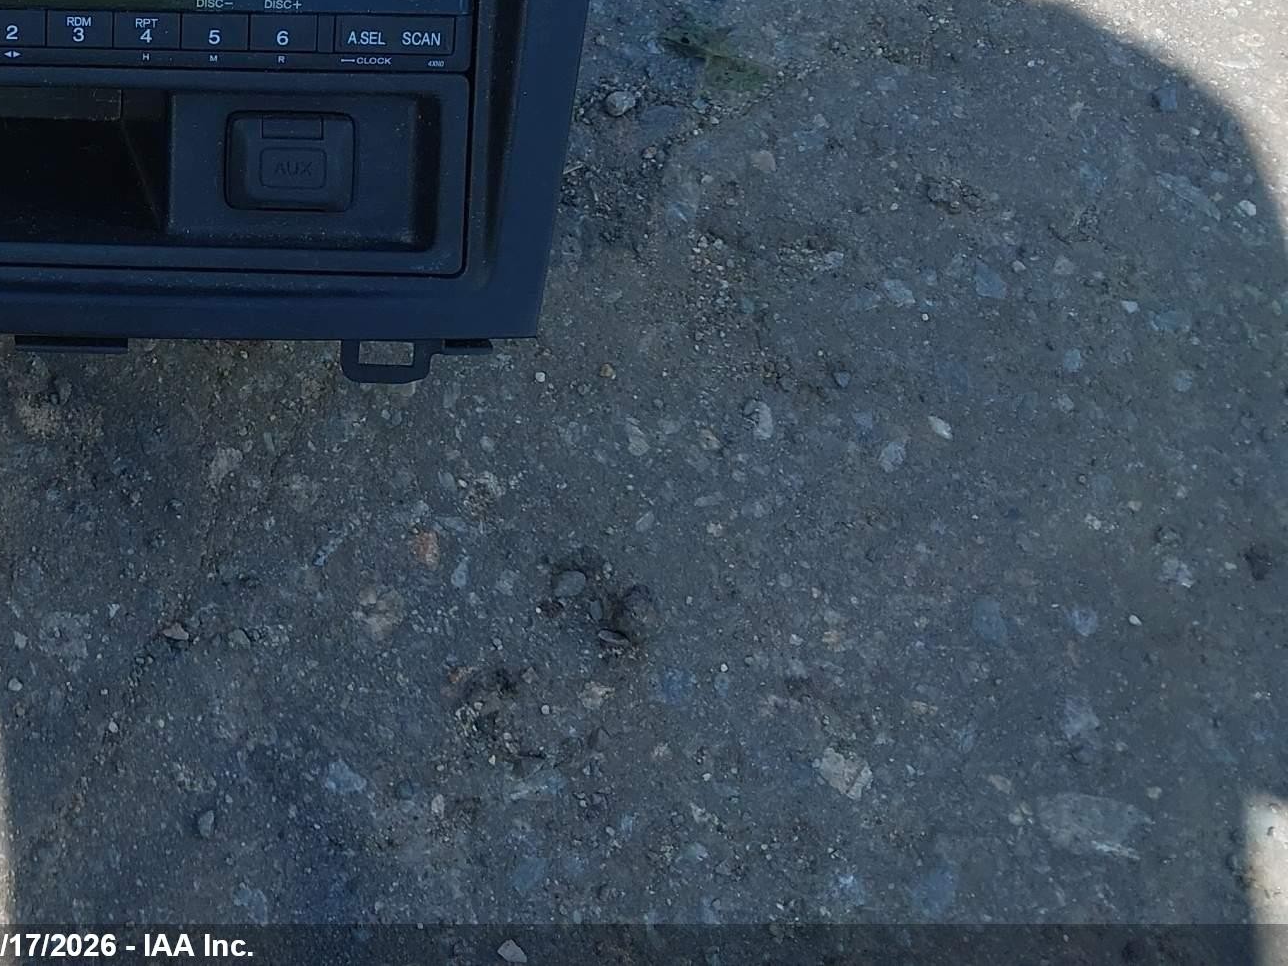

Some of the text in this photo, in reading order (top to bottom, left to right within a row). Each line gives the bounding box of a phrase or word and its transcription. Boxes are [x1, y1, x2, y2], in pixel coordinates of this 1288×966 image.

[264, 0, 302, 10] DISC+
[66, 16, 92, 27] RDM
[135, 18, 159, 28] RPT
[5, 25, 19, 40] 2
[72, 27, 85, 42] 3
[139, 28, 153, 43] 4
[208, 30, 221, 45] 5
[276, 31, 289, 46] 6
[347, 31, 441, 46] A.SEL SCAN
[142, 53, 150, 61] H
[278, 55, 286, 63] R
[356, 57, 392, 65] CLOCK
[275, 162, 313, 175] AUX
